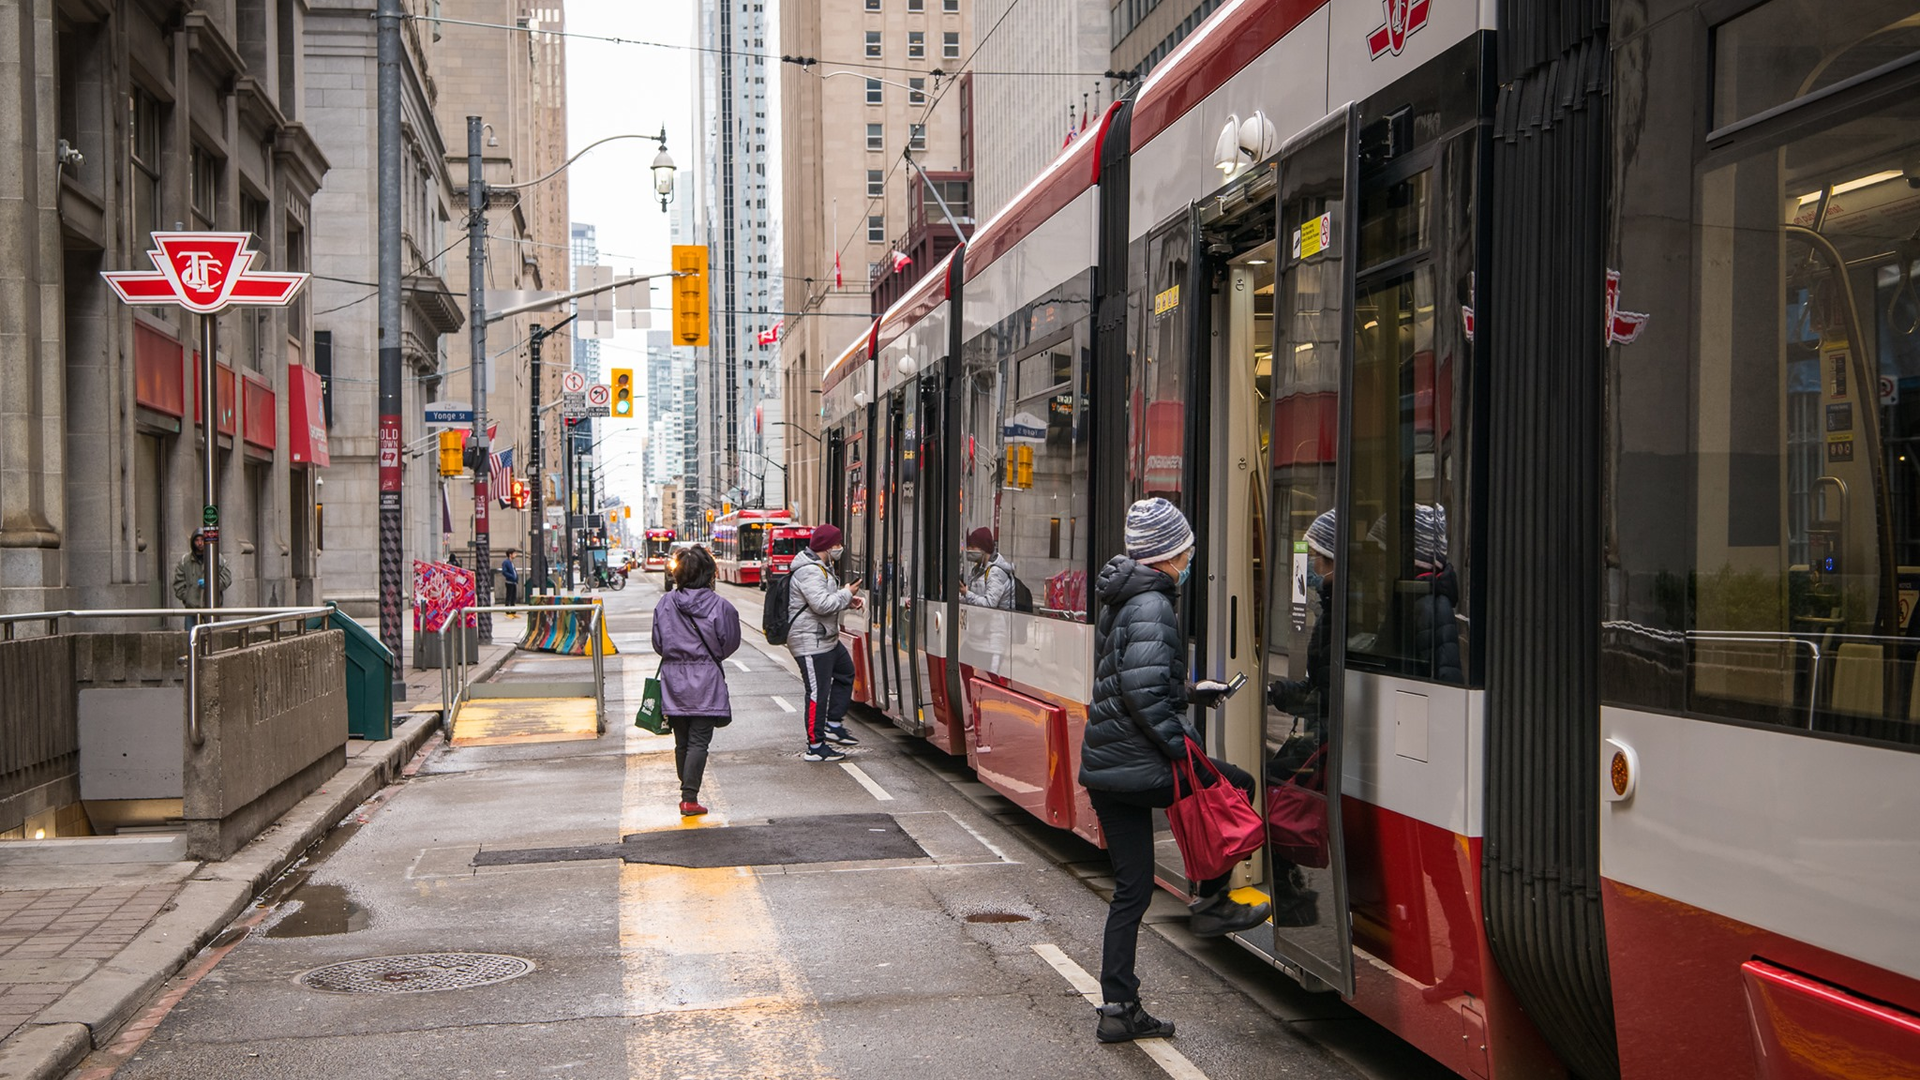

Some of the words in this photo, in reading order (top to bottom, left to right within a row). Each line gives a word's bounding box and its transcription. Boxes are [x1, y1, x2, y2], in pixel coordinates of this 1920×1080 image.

[176, 251, 223, 293] TTC
[433, 412, 456, 421] Yonge
[380, 429, 398, 440] OLD
[380, 440, 398, 448] TOWN
